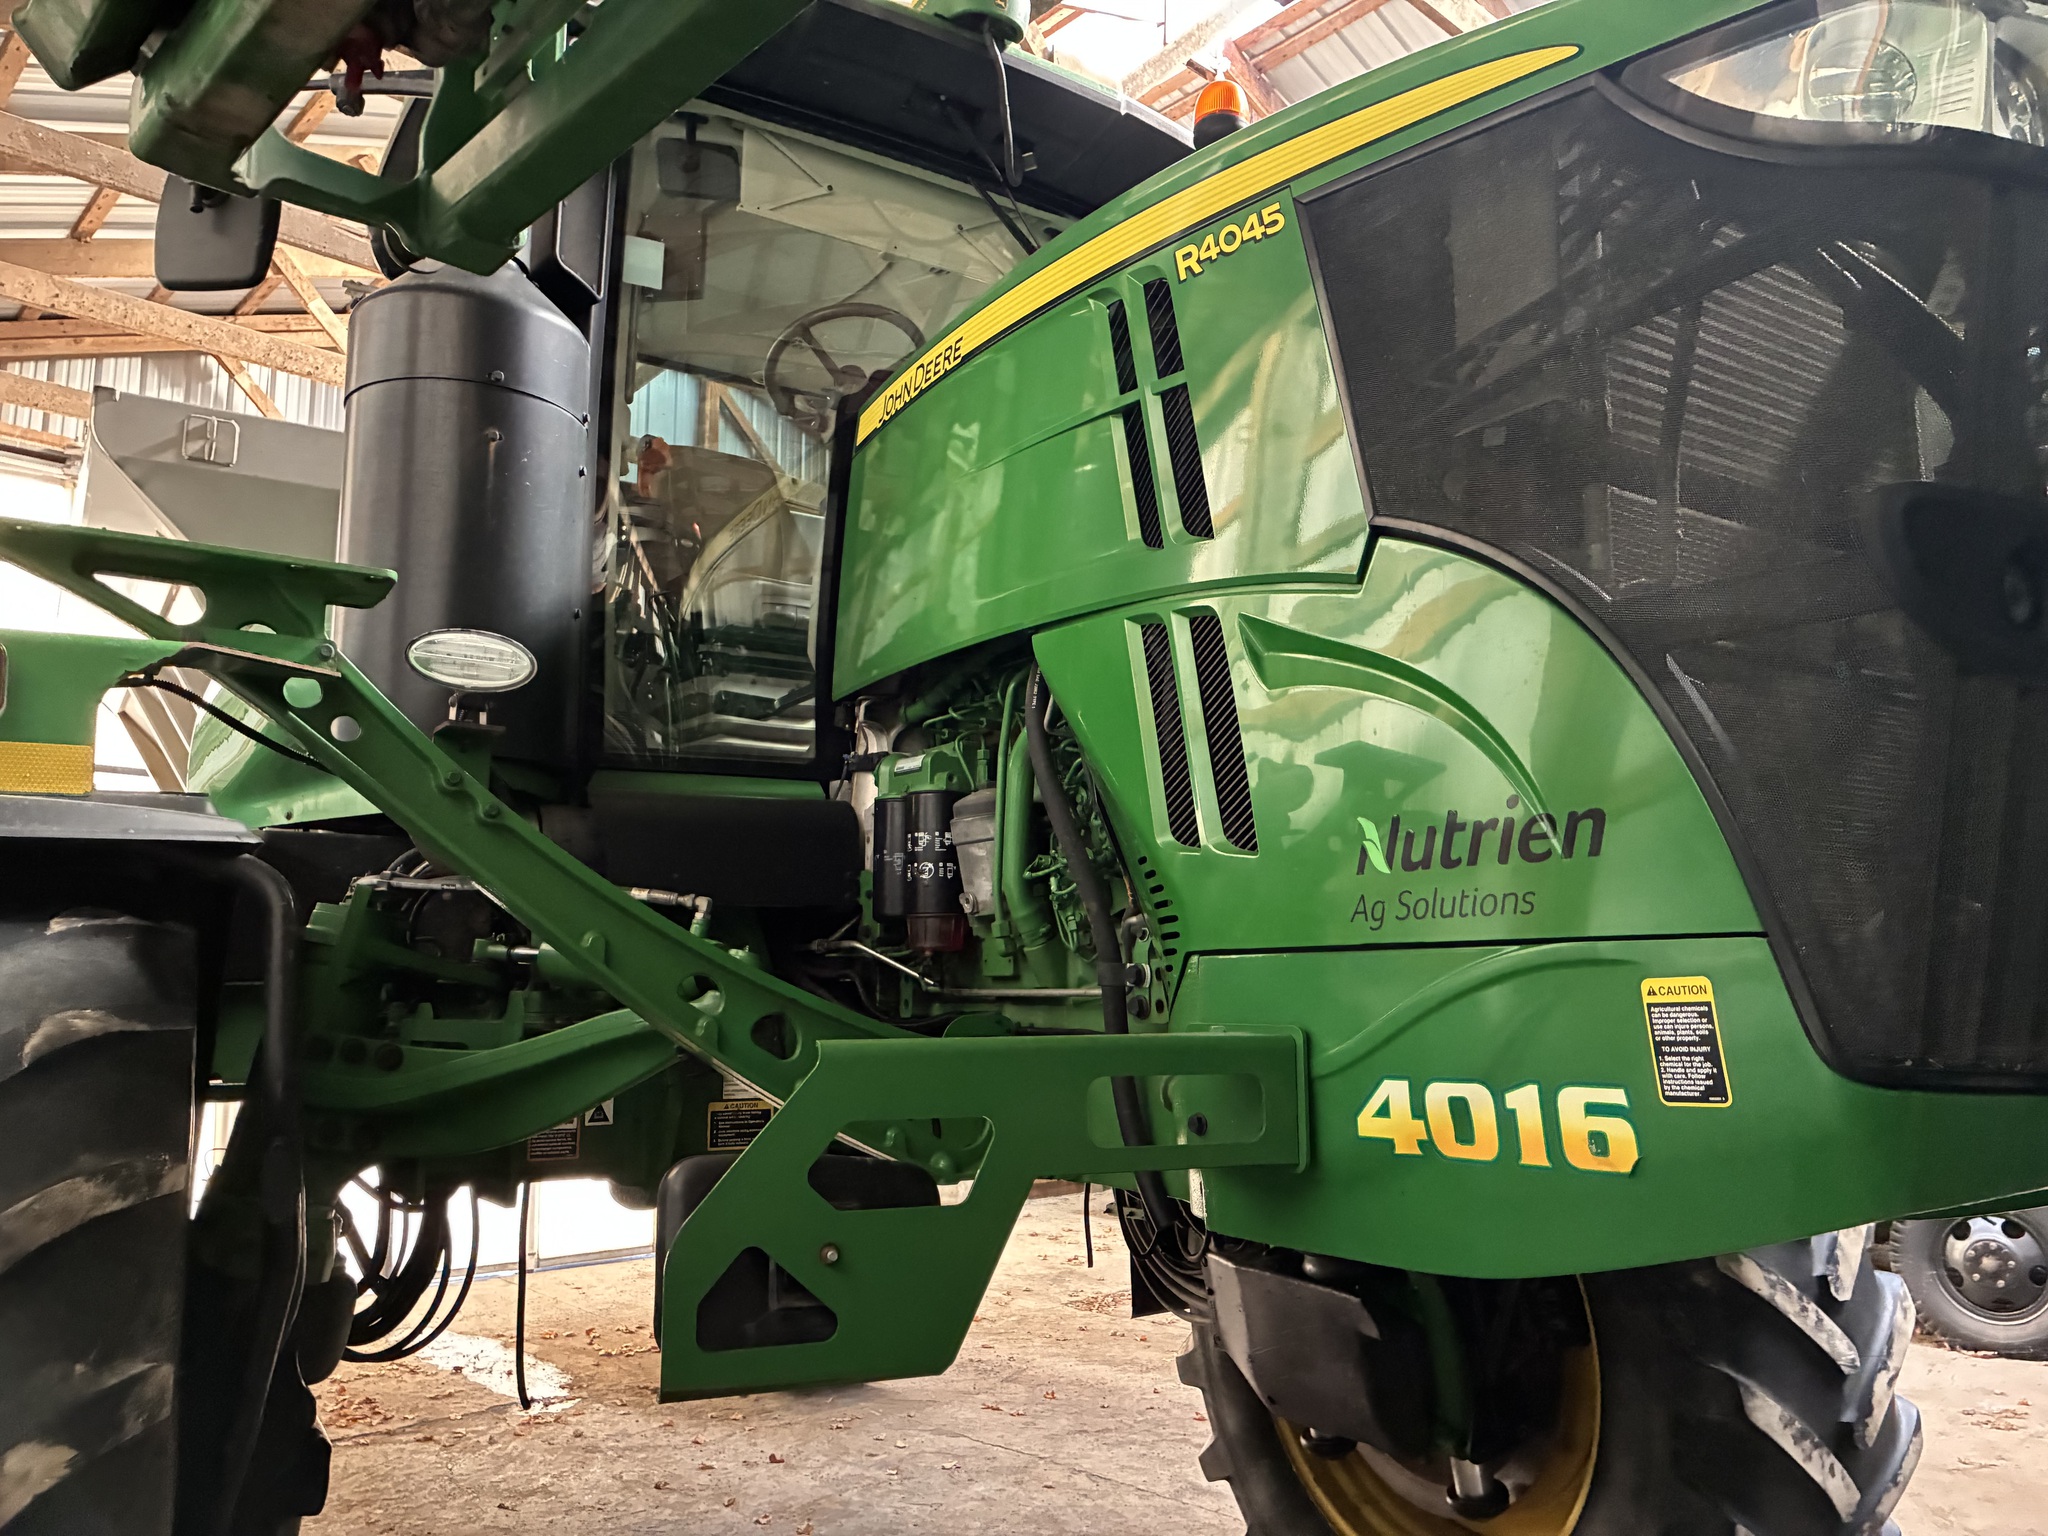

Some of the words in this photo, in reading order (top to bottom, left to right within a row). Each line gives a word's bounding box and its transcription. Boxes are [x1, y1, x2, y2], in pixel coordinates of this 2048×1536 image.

[1174, 201, 1286, 285] R4045
[878, 376, 913, 424] JOHN
[913, 336, 964, 393] DEERE
[1356, 794, 1606, 876] Nutrien
[1351, 894, 1386, 931] Ag
[1395, 887, 1536, 921] Solutions
[1658, 985, 1707, 996] CAUTION
[1355, 1077, 1640, 1174] 4016
